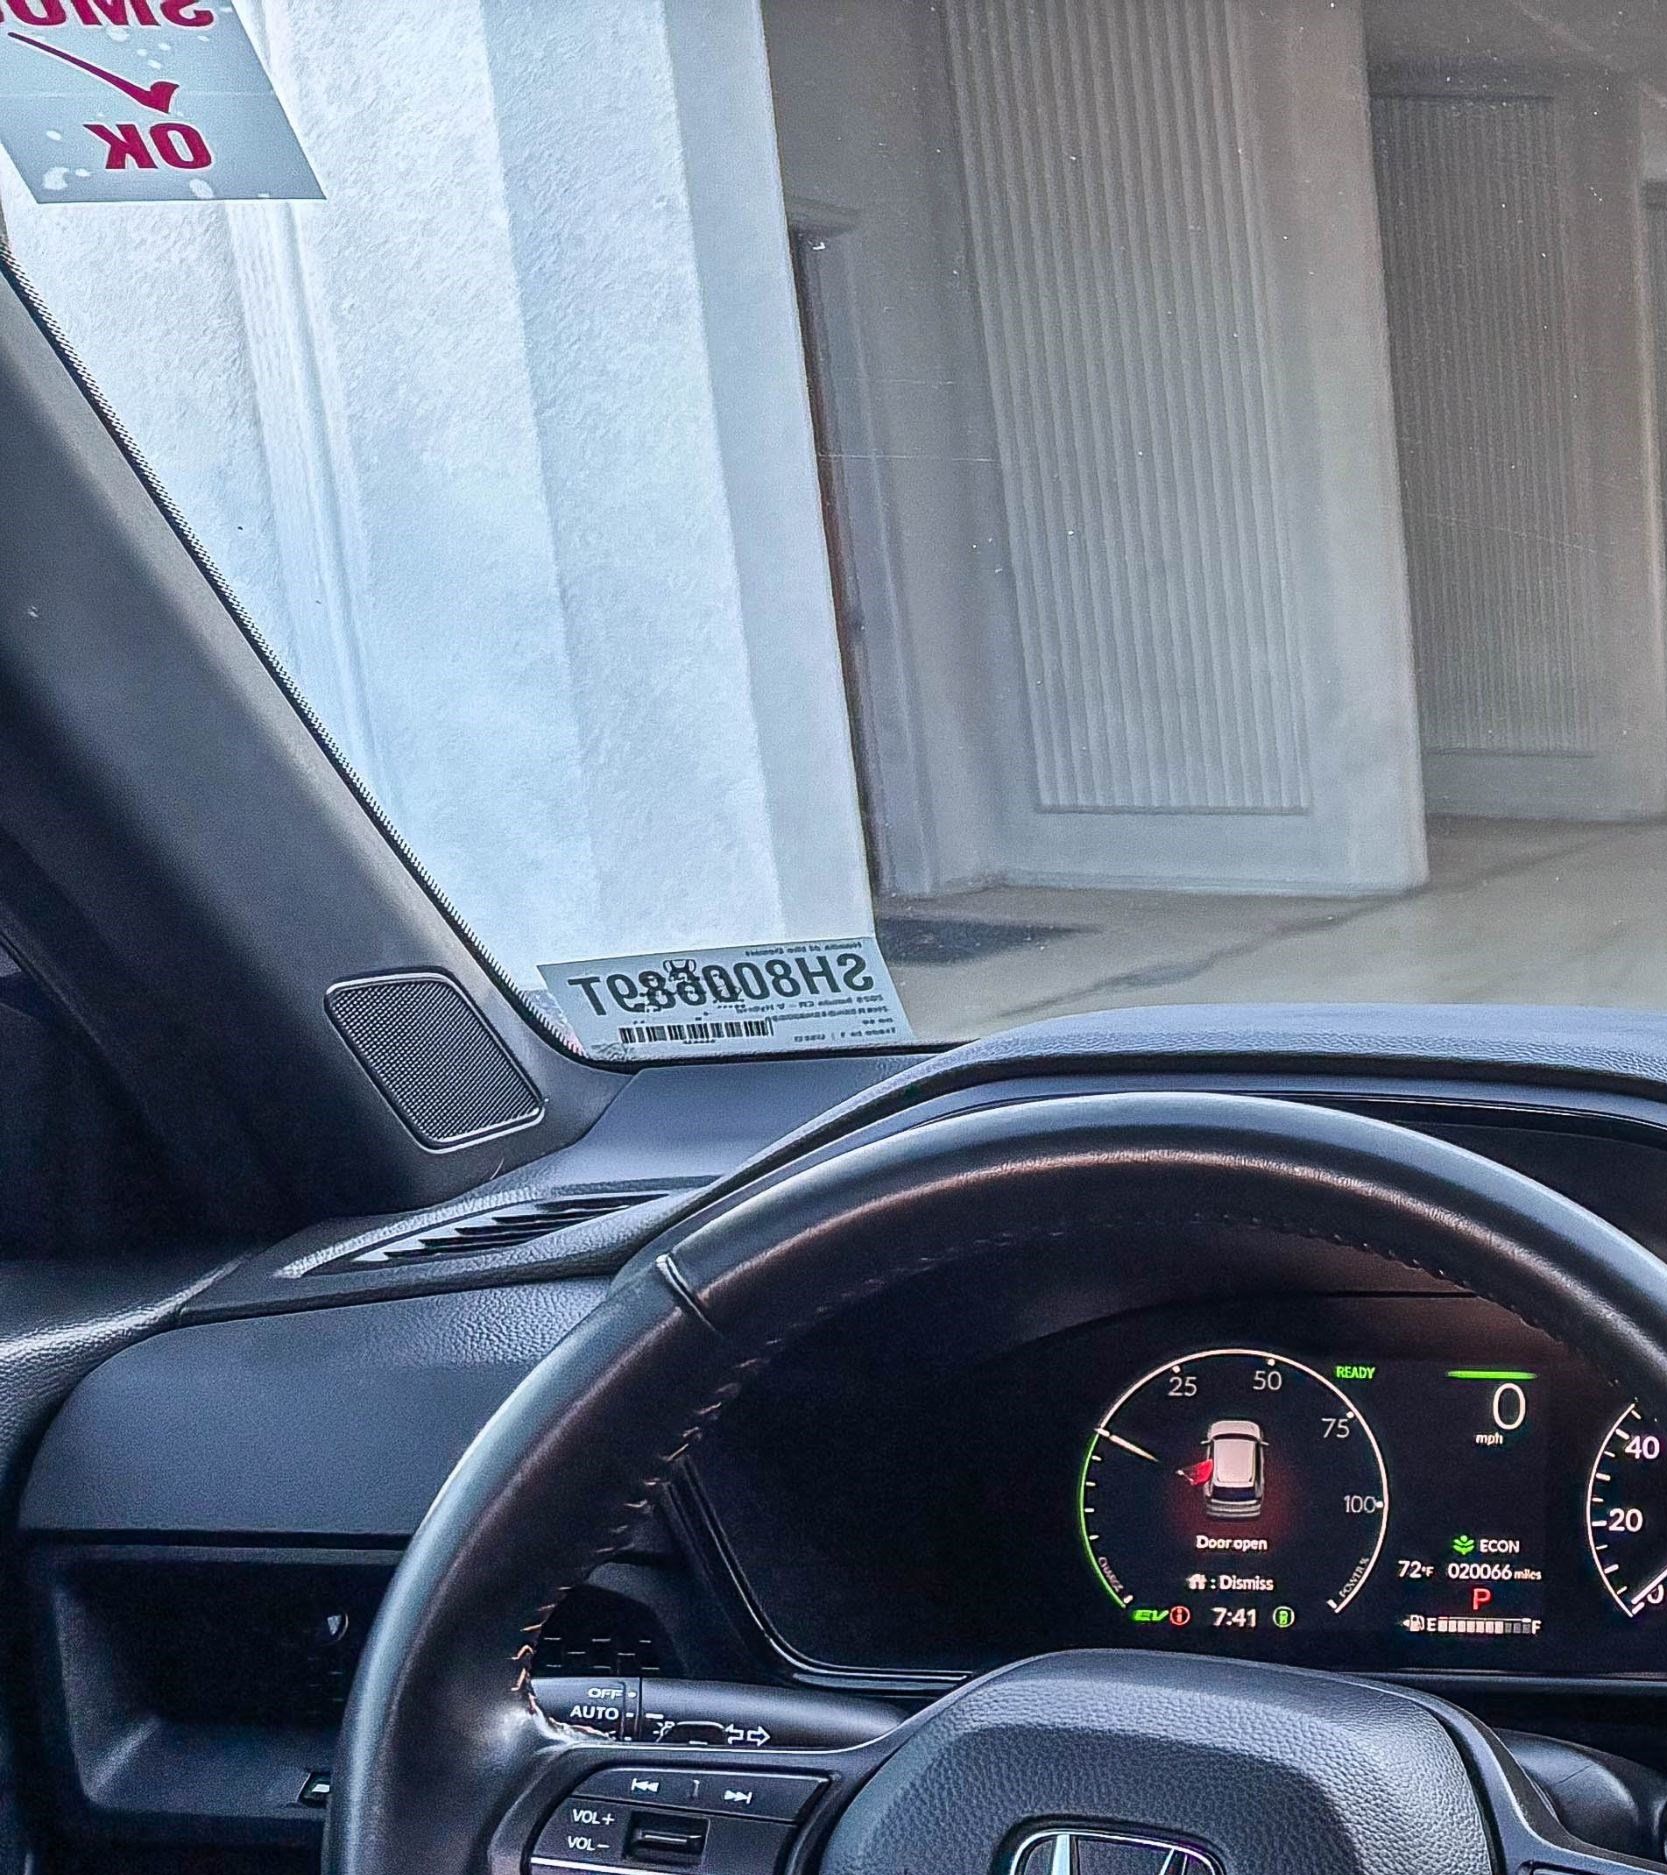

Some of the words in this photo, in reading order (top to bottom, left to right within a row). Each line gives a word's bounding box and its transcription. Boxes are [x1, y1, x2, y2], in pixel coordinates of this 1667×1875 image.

[1252, 1371, 1283, 1391] 50
[1336, 1365, 1375, 1379] READY
[1168, 1378, 1198, 1398] 25
[1492, 1383, 1526, 1430] 0
[1321, 1418, 1350, 1439] 75
[1475, 1432, 1504, 1446] mph
[1624, 1436, 1660, 1460] 40
[1343, 1495, 1376, 1514] 100
[1608, 1509, 1644, 1533] 20
[1196, 1535, 1233, 1551] Door
[1234, 1537, 1268, 1554] open
[1480, 1540, 1520, 1553] ECON
[1398, 1560, 1434, 1578] 72°F
[1447, 1563, 1512, 1580] 020066
[1513, 1569, 1542, 1581] miles
[1219, 1574, 1274, 1592] Dismiss
[1473, 1588, 1491, 1610] P
[1133, 1610, 1168, 1622] EV
[1211, 1607, 1257, 1628] 7:41
[1427, 1618, 1437, 1631] E
[1531, 1620, 1542, 1634] F
[588, 1689, 623, 1699] OFF
[570, 1707, 619, 1720] AUTO
